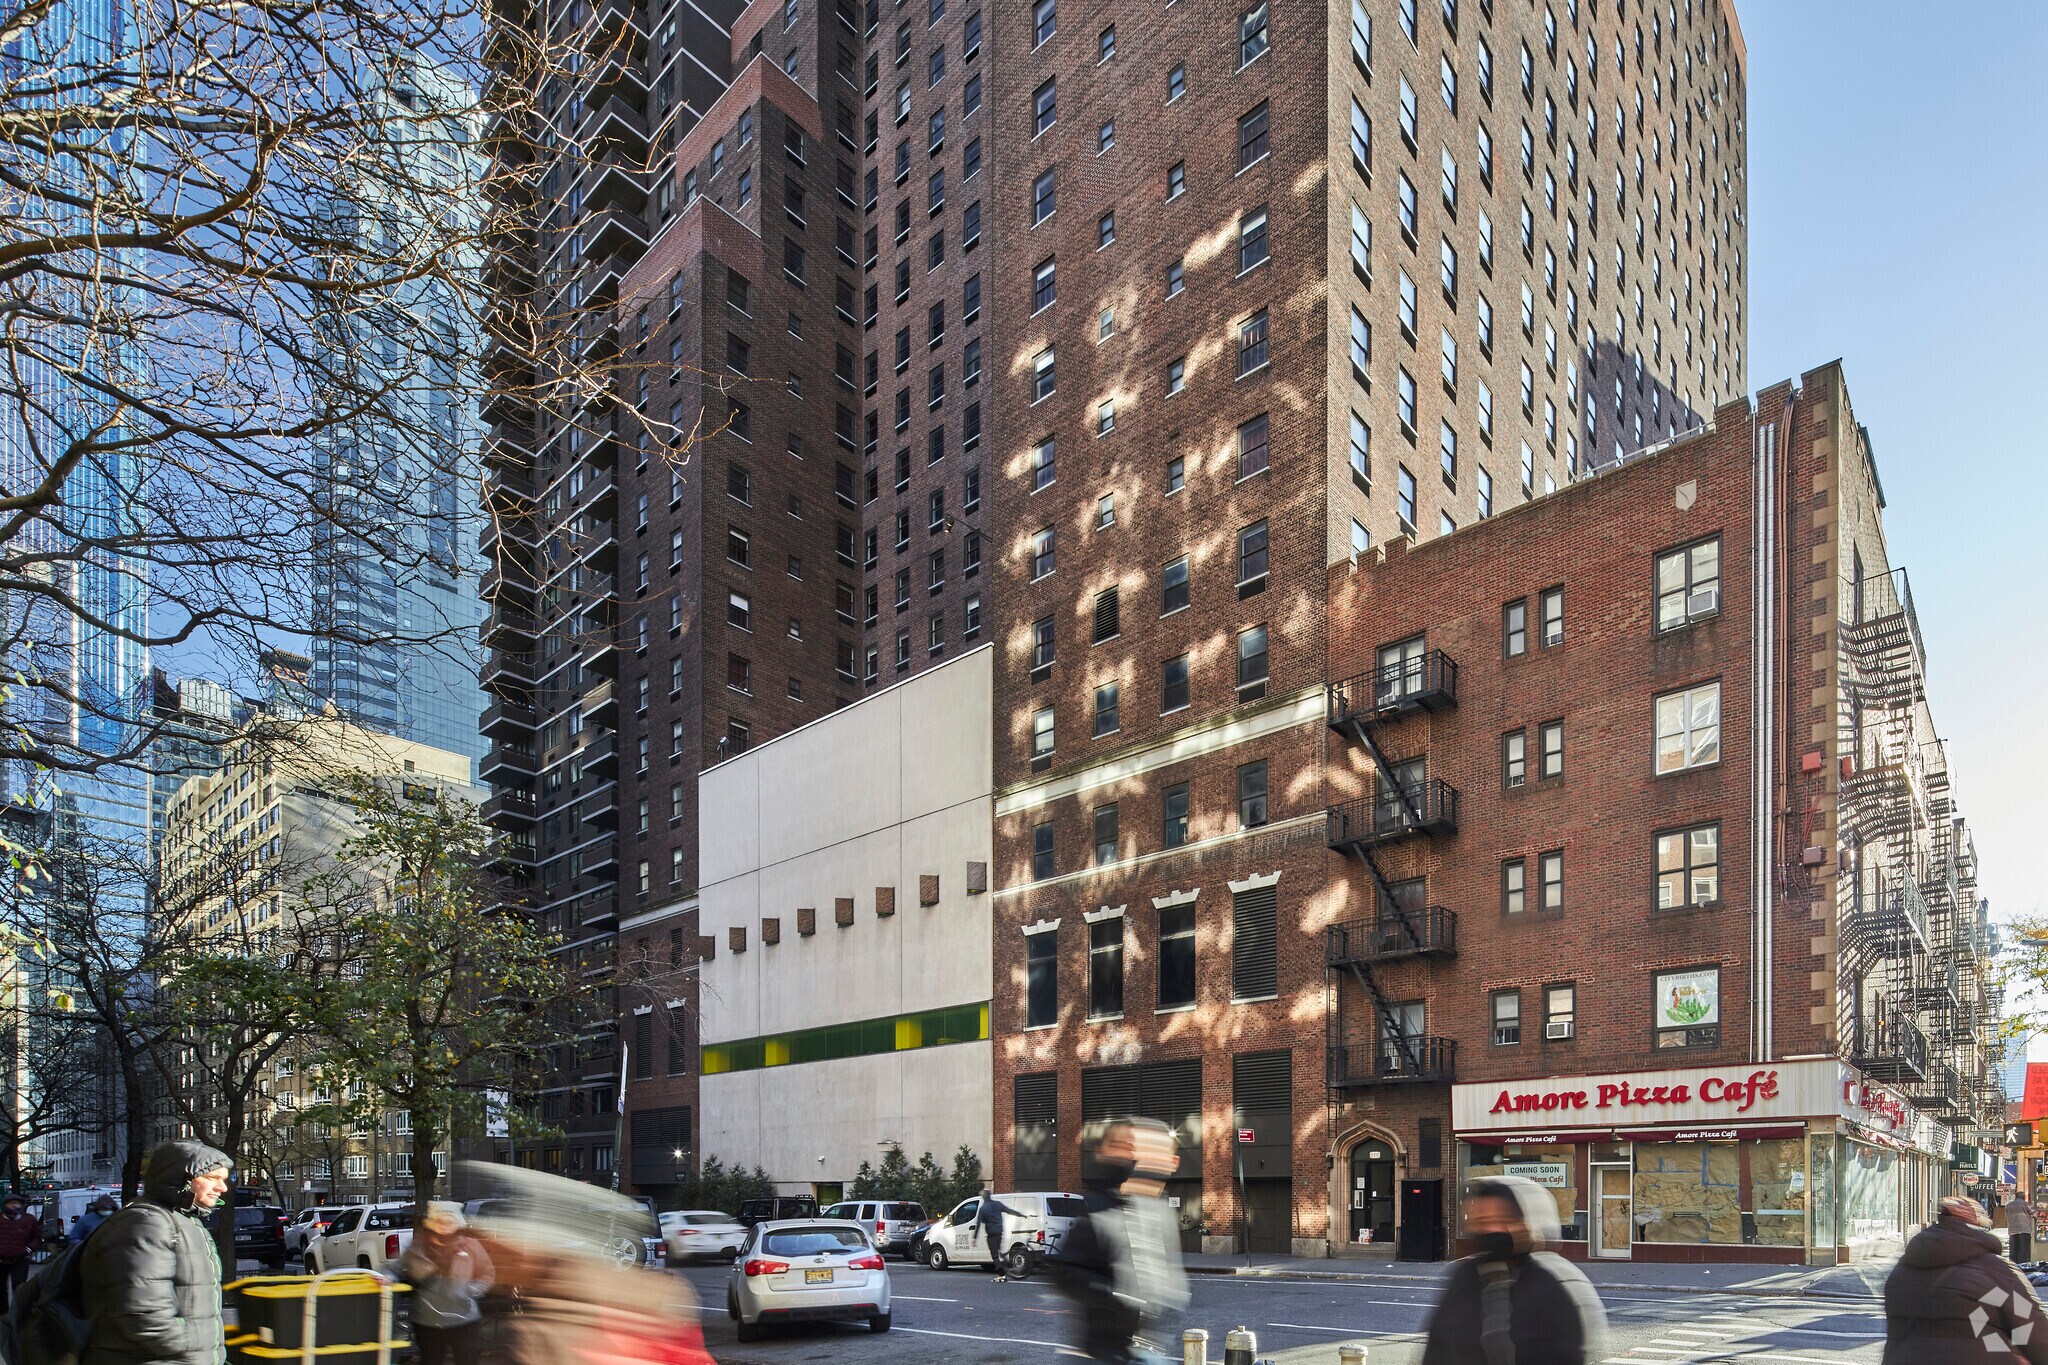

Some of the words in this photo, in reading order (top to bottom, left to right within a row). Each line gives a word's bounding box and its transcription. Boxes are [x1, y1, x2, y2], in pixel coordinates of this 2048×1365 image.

[1489, 1090, 1588, 1113] Amore
[1595, 1080, 1691, 1109] Pizza
[1699, 1070, 1779, 1112] Café
[1721, 1129, 1737, 1139] Café
[1543, 1135, 1557, 1143] Café
[1549, 1176, 1564, 1185] Café
